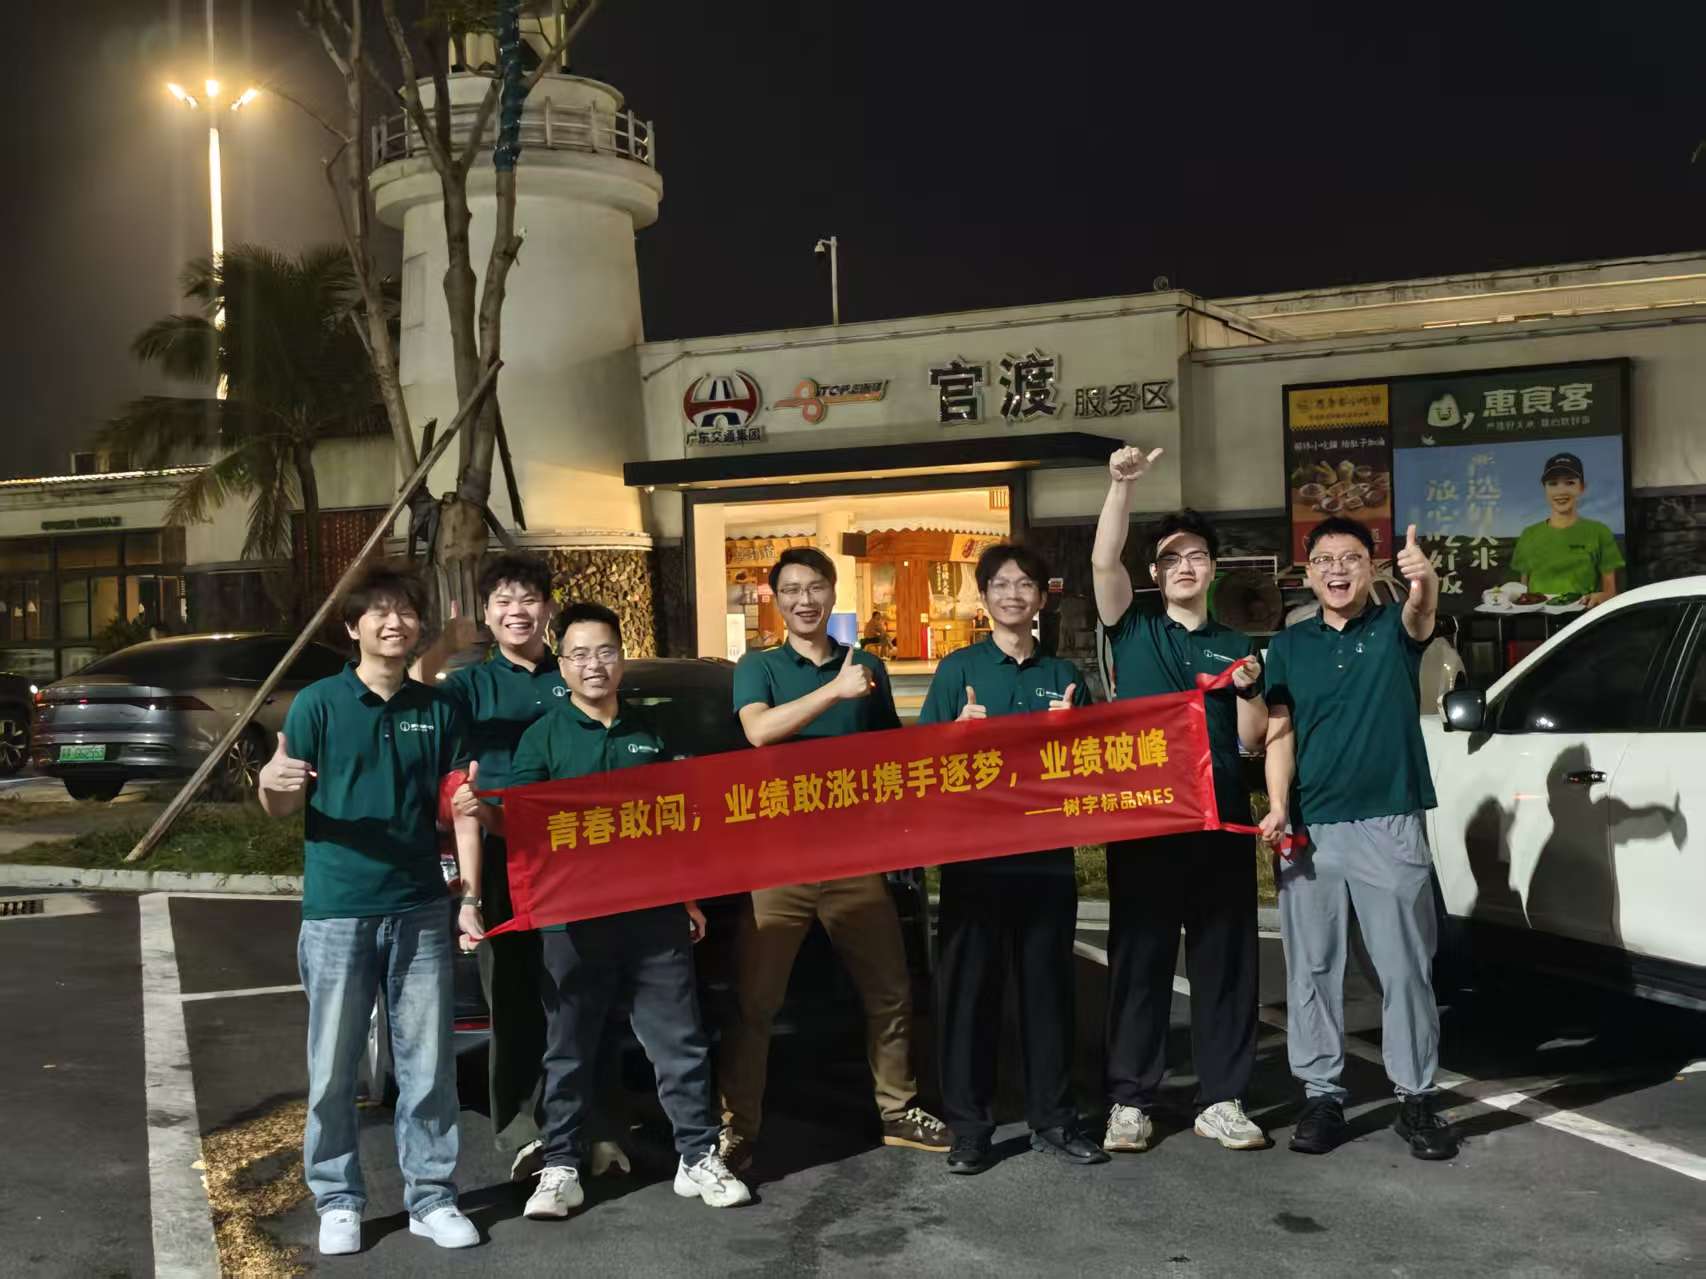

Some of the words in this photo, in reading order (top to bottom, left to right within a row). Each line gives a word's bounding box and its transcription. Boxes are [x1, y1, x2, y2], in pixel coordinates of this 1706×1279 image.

[930, 349, 1057, 421] 官渡
[1074, 380, 1170, 417] 服务区
[1483, 383, 1593, 417] 惠食客
